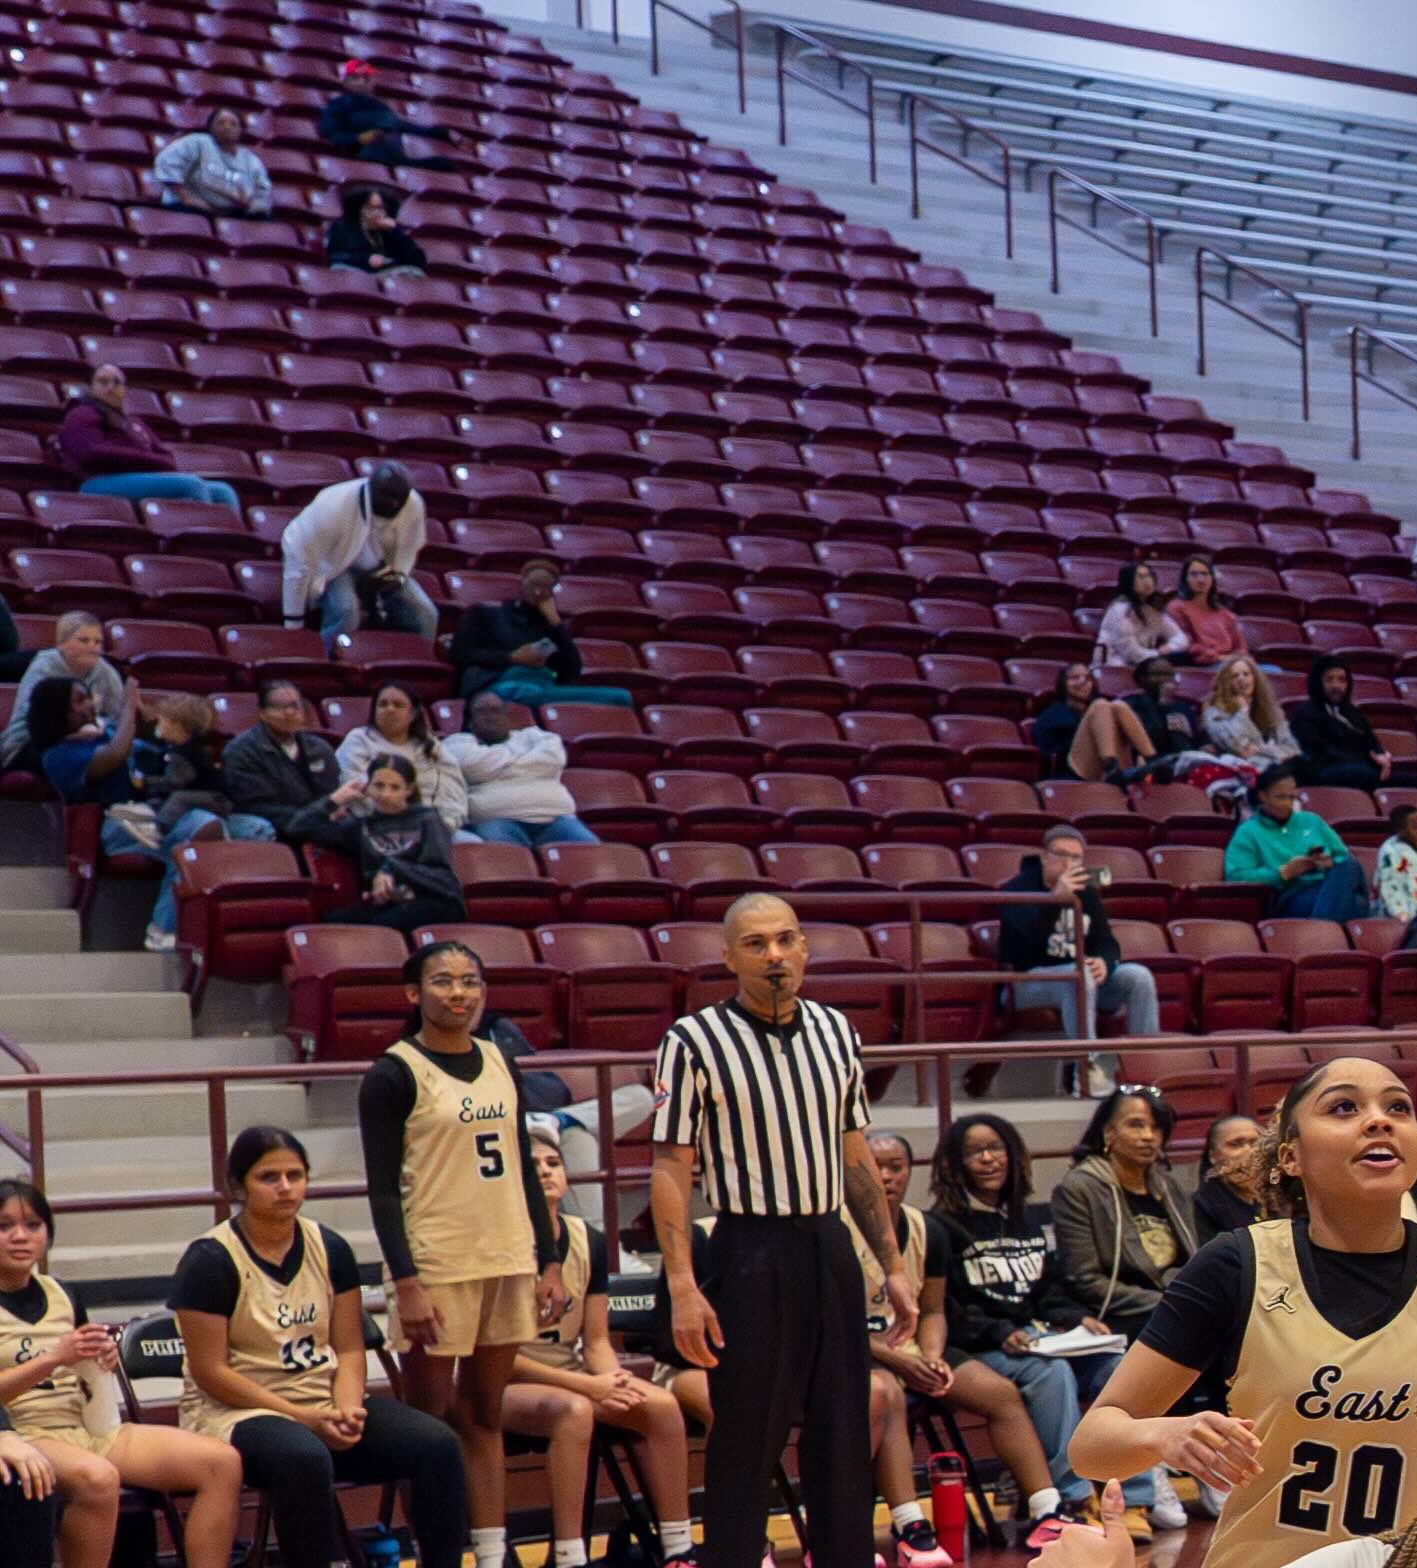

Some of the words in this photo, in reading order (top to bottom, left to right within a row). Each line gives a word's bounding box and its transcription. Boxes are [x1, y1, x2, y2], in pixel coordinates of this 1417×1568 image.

[459, 1097, 507, 1123] East
[475, 1131, 505, 1182] 5
[277, 1302, 317, 1329] East
[1296, 1364, 1411, 1423] East
[1276, 1440, 1406, 1537] 20
